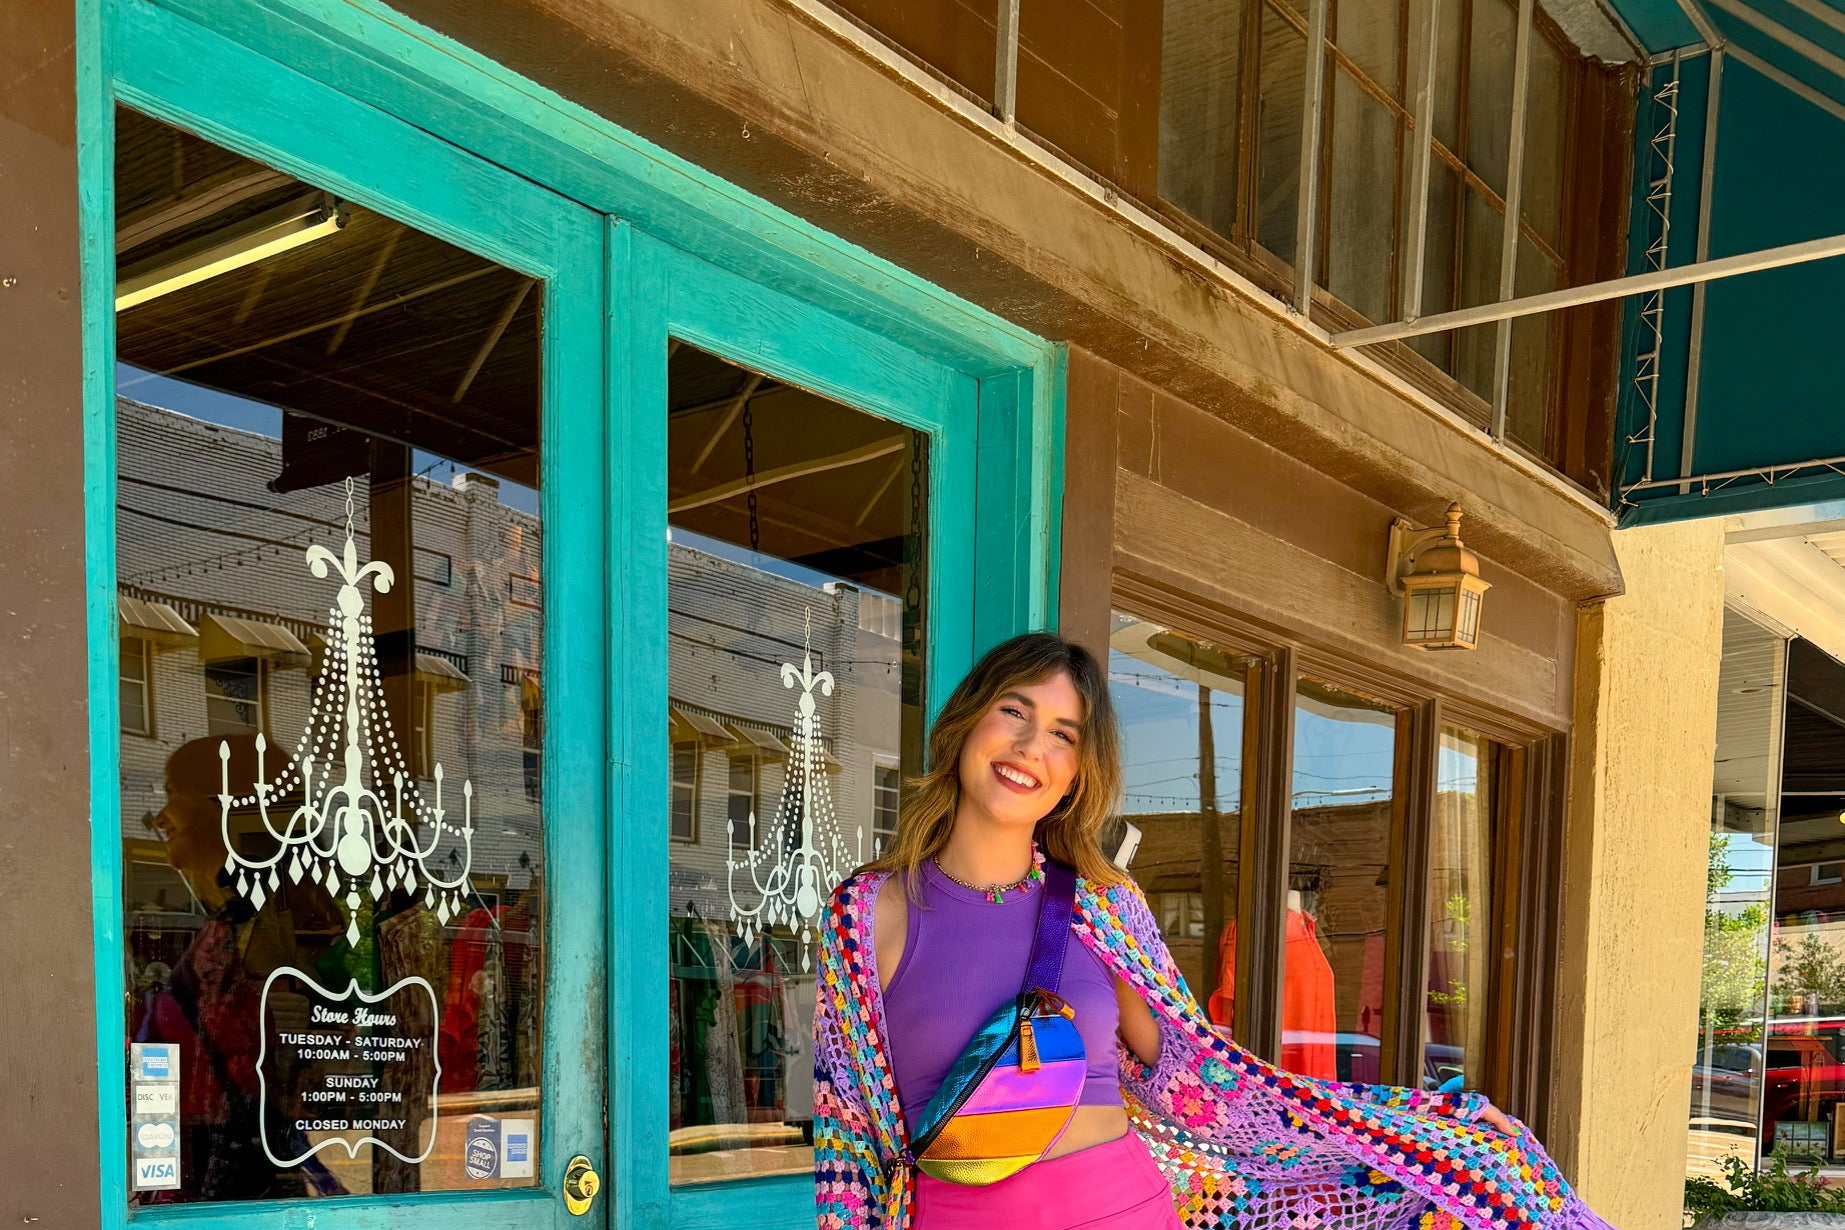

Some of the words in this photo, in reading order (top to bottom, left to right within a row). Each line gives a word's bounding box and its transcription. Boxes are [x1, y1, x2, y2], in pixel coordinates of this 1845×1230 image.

[311, 1005, 349, 1023] Store
[352, 1007, 397, 1026] Hours
[279, 1033, 342, 1046] TUESDAY
[354, 1036, 422, 1049] SATURDAY
[297, 1048, 350, 1060] 10:00AM
[362, 1050, 406, 1062] 5:00PM
[325, 1077, 379, 1088] SUNDAY
[137, 1093, 173, 1101] DISCVER
[301, 1091, 346, 1102] 1:00PM
[358, 1092, 402, 1102] 5:00PM
[295, 1119, 349, 1130] CLOSED
[352, 1119, 406, 1130] MONDAY
[471, 1149, 491, 1160] SHOP
[469, 1156, 490, 1169] SMALL
[141, 1164, 174, 1179] VISA
